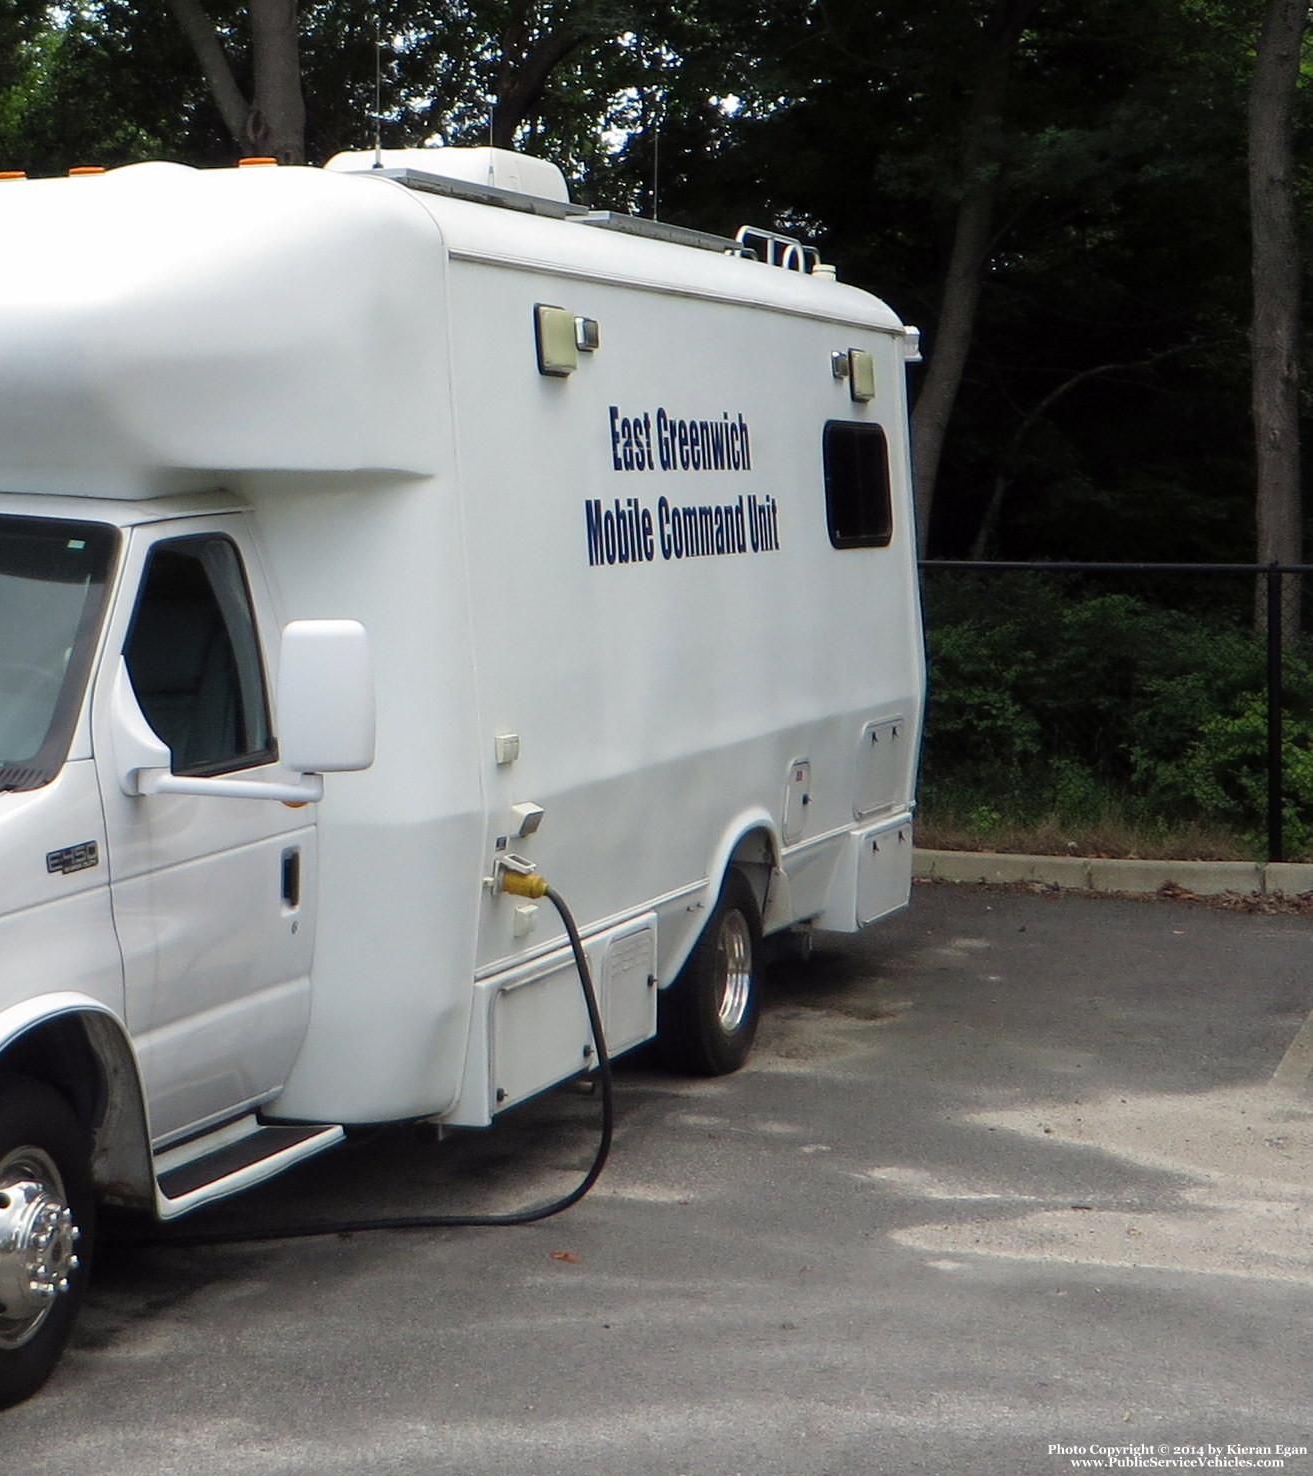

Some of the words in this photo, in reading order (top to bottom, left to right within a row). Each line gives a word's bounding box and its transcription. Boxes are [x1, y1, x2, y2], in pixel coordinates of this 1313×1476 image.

[609, 405, 654, 471] East
[657, 406, 751, 471] Greenwich
[585, 497, 654, 566] Mobile
[657, 494, 747, 560] Command
[747, 494, 780, 553] Unit
